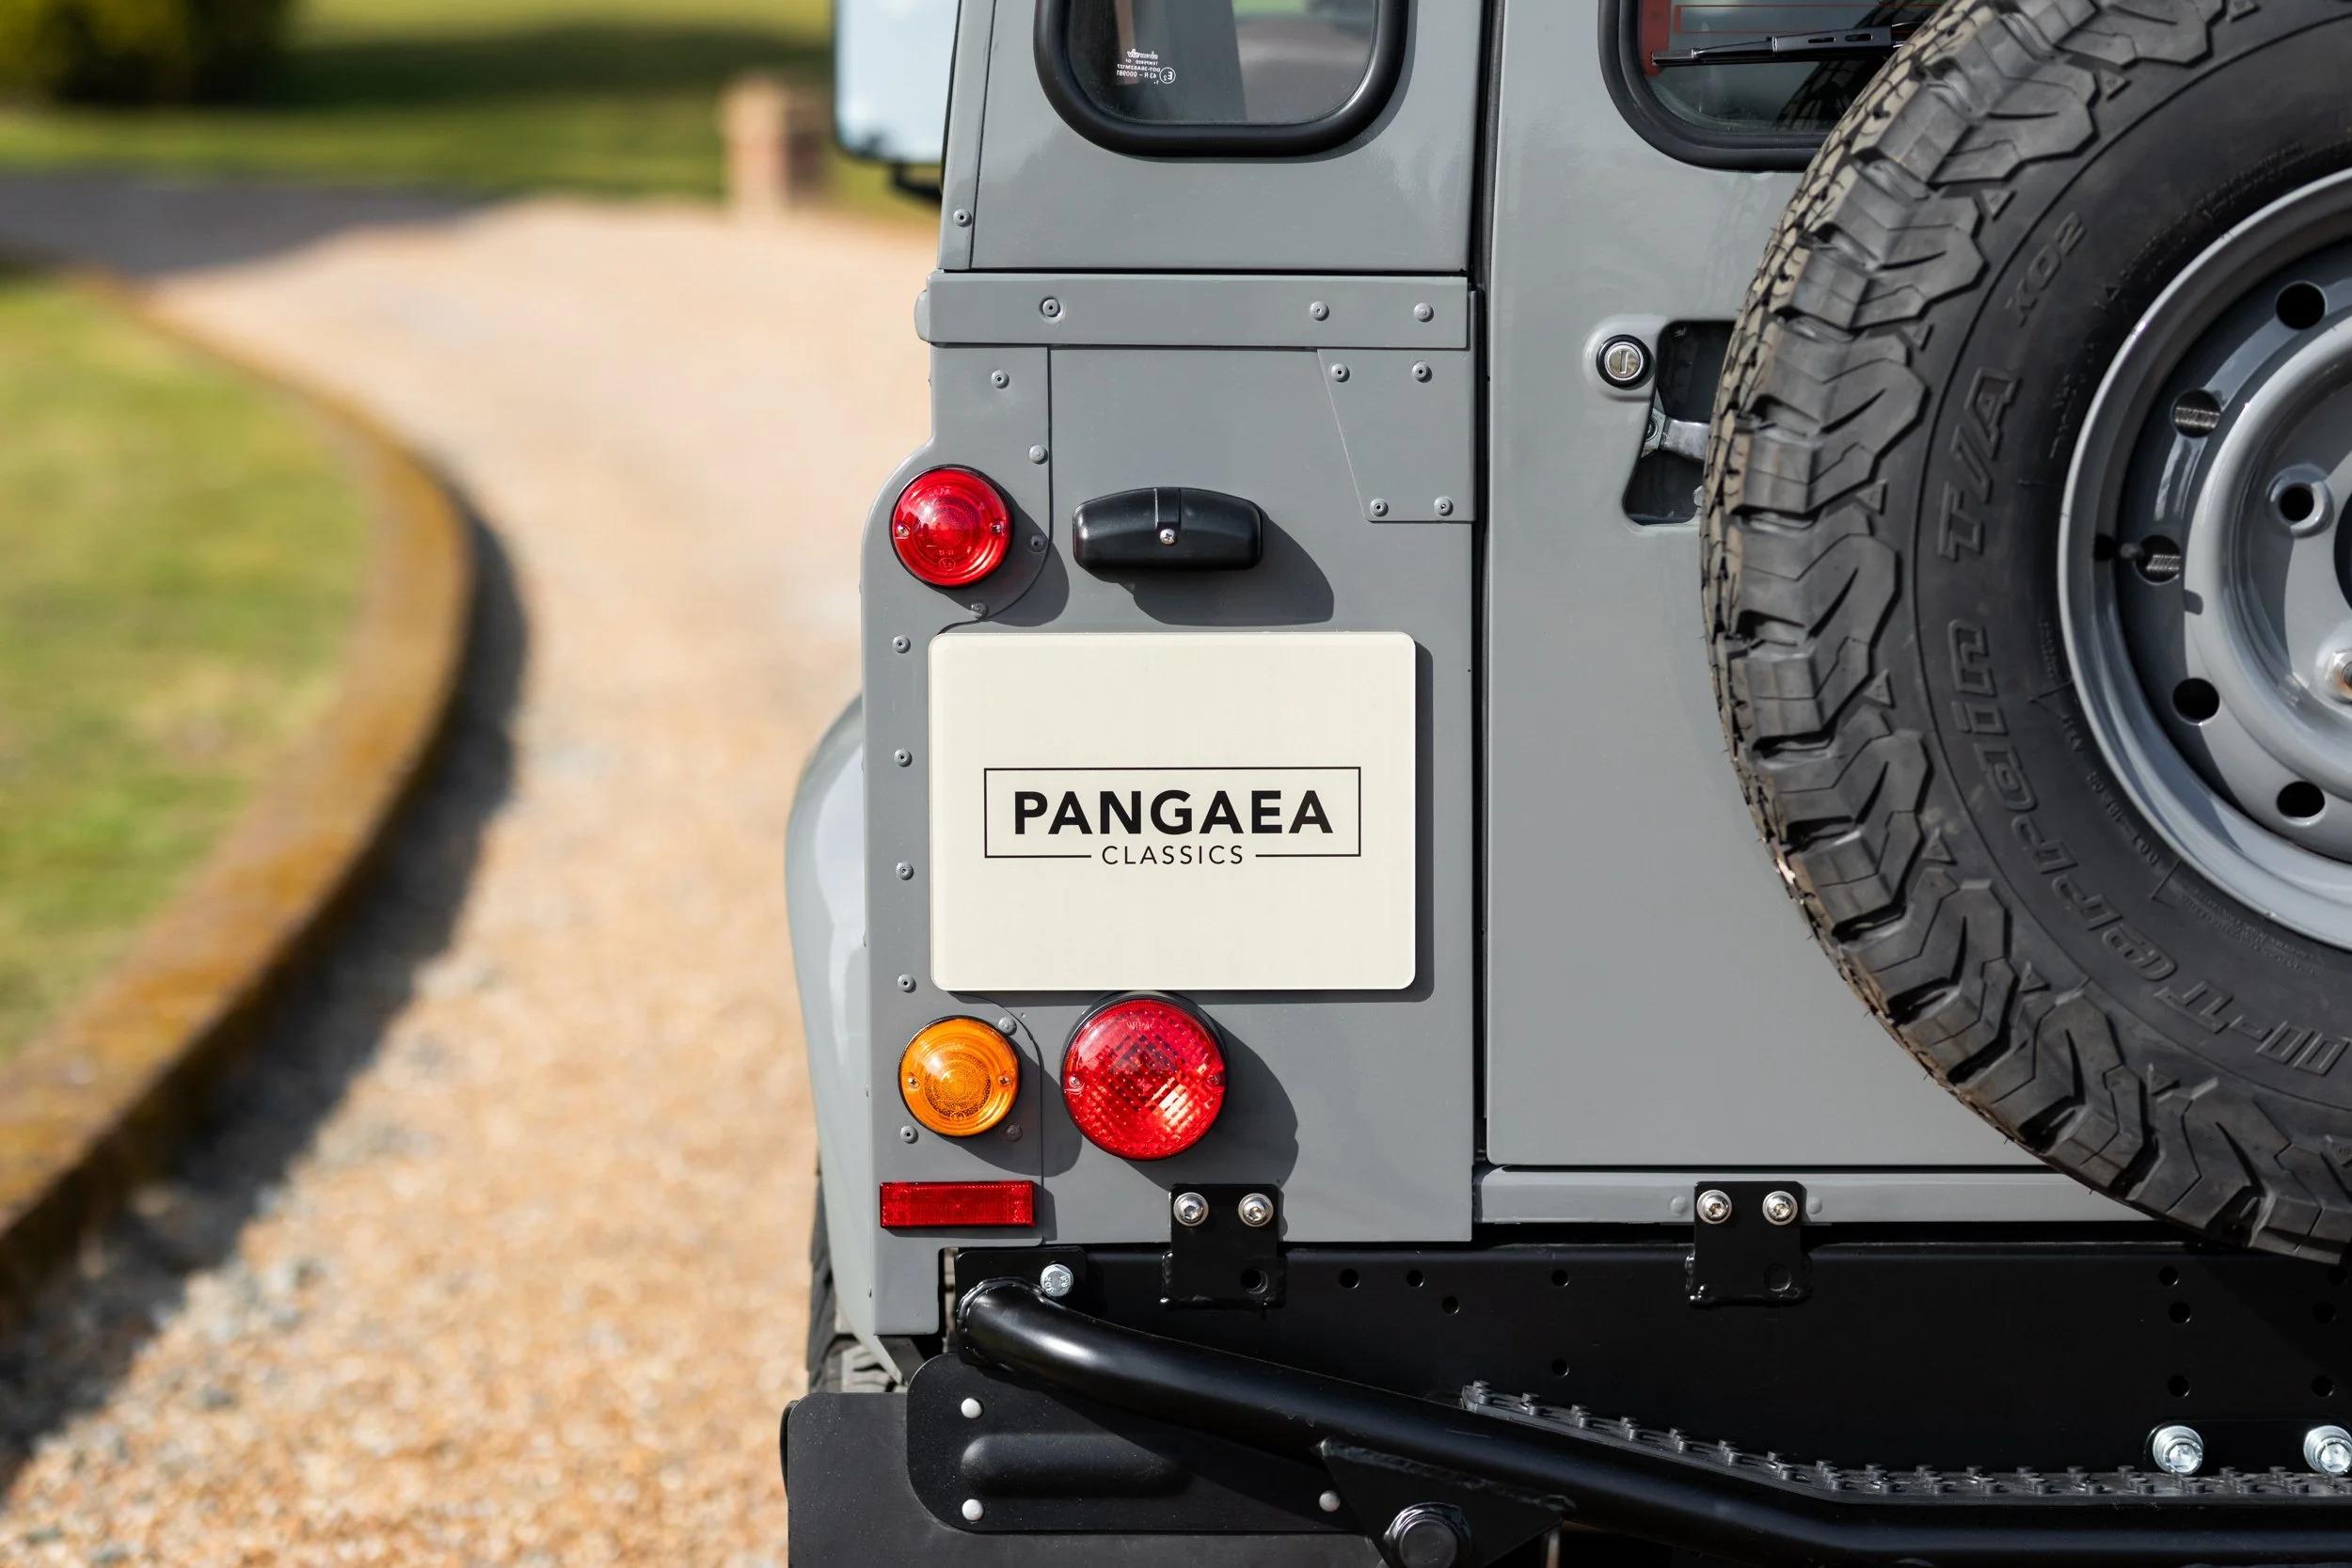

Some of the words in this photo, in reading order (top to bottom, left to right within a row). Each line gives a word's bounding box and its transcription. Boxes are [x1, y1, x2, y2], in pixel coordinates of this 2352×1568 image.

[1938, 365, 2023, 563] T/A
[1014, 789, 1334, 835] PANGAEA
[1102, 845, 1244, 865] CLASSICS
[1948, 619, 2351, 1077] ll-Terrain
